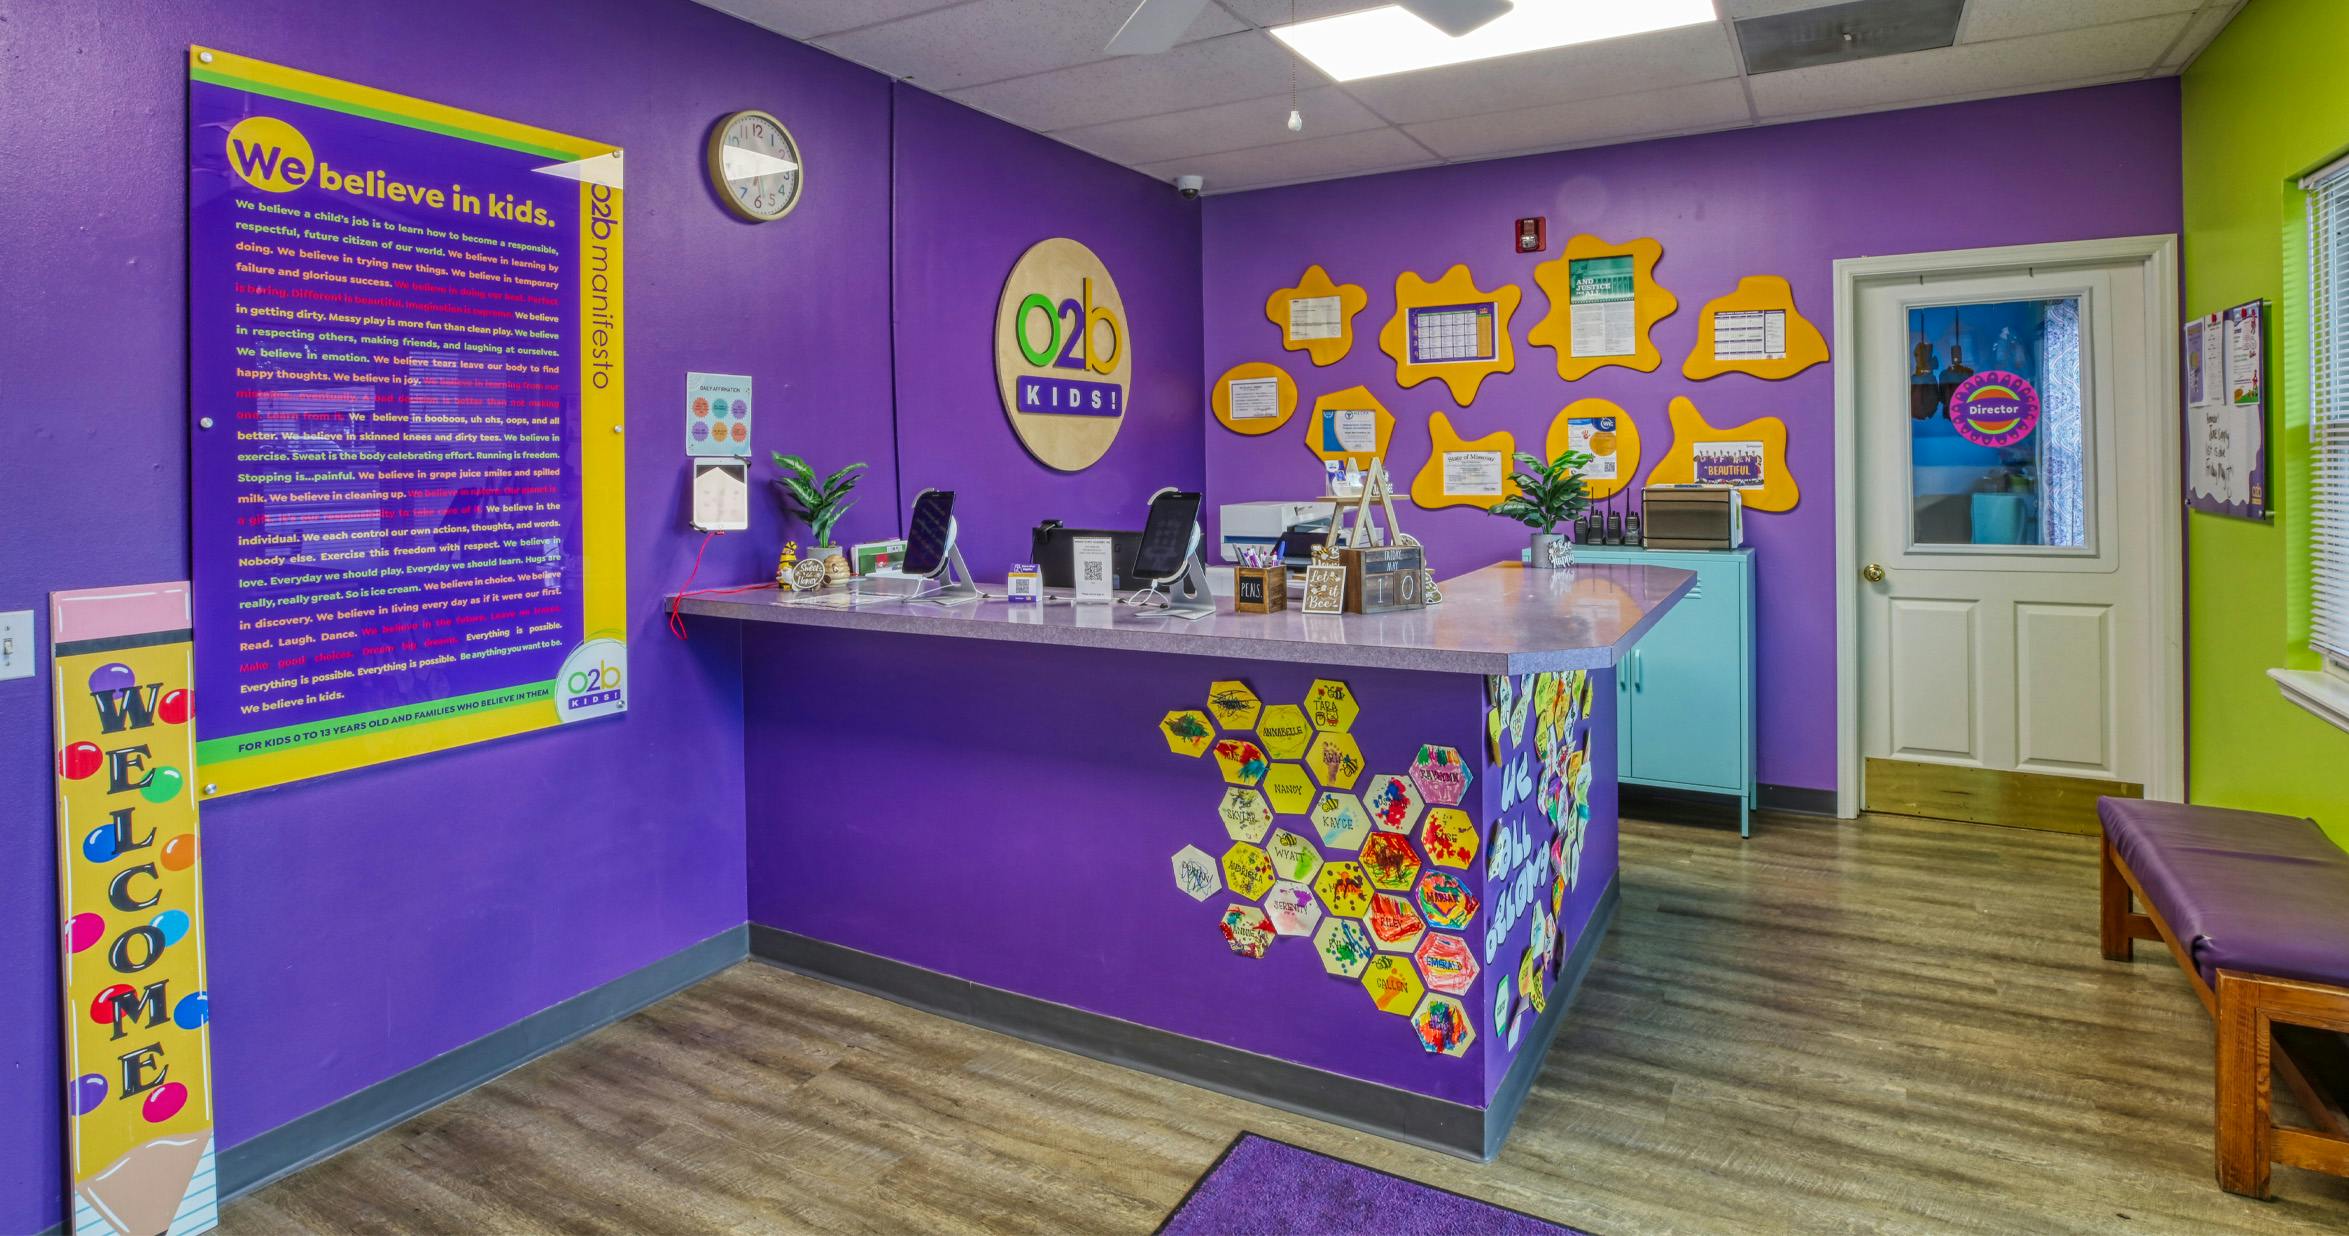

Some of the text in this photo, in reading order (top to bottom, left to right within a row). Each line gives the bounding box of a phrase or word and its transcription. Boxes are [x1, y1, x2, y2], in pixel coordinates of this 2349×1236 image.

[740, 126, 748, 138] 11
[752, 124, 764, 138] 12
[770, 134, 774, 147] 1
[232, 138, 556, 228] We believe in kids.
[778, 184, 784, 196] 4
[740, 186, 748, 199] 7
[769, 193, 775, 206] 5
[754, 195, 762, 208] 6
[235, 196, 255, 209] We
[258, 200, 300, 216] believe
[304, 209, 311, 218] a
[314, 209, 349, 224] child's
[351, 214, 369, 229] job
[372, 218, 381, 228] is
[383, 220, 395, 230] to
[398, 222, 424, 235] learn
[426, 226, 446, 238] how
[448, 230, 459, 240] to
[461, 232, 498, 246] become
[507, 239, 558, 257] responsible,
[235, 218, 559, 274] respectful, future citizen of our world. We believe in learning by
[234, 239, 559, 291] doing. We believe in trying new things. We believe in temporary
[591, 184, 618, 389] o2b manifesto
[1016, 278, 1122, 375] o2b
[235, 324, 559, 357] in respecting others, making friends, and laughing at ourselves.
[1027, 385, 1116, 409] KIDS!
[1969, 404, 2019, 414] Director
[237, 450, 559, 463] exercise. Sweat is the body celebrating effort. Running is freedom.
[1708, 466, 1751, 475] BEAUTIFUL
[238, 535, 560, 570] Nobody else. Exercise this freedom with respect. We believe in
[1386, 561, 1399, 571] MAY
[1311, 570, 1329, 582] Let
[1241, 582, 1263, 599] PENS.
[1329, 585, 1338, 597] it
[568, 658, 620, 694] o2b
[240, 688, 345, 715] We believe in kids.
[572, 692, 618, 707] KIDS!
[1314, 700, 1337, 712] TARA
[238, 687, 548, 753] FOR KIDS 0 TO 13 YEARS OLD AND FAMILIES WHO BELIEVE IN THEM
[1263, 727, 1303, 736] ANNABELLE
[1322, 816, 1353, 830] KAYCE
[1274, 847, 1304, 862] WYATT
[90, 683, 170, 1101] WELCOME
[1274, 900, 1307, 914] SERENITY
